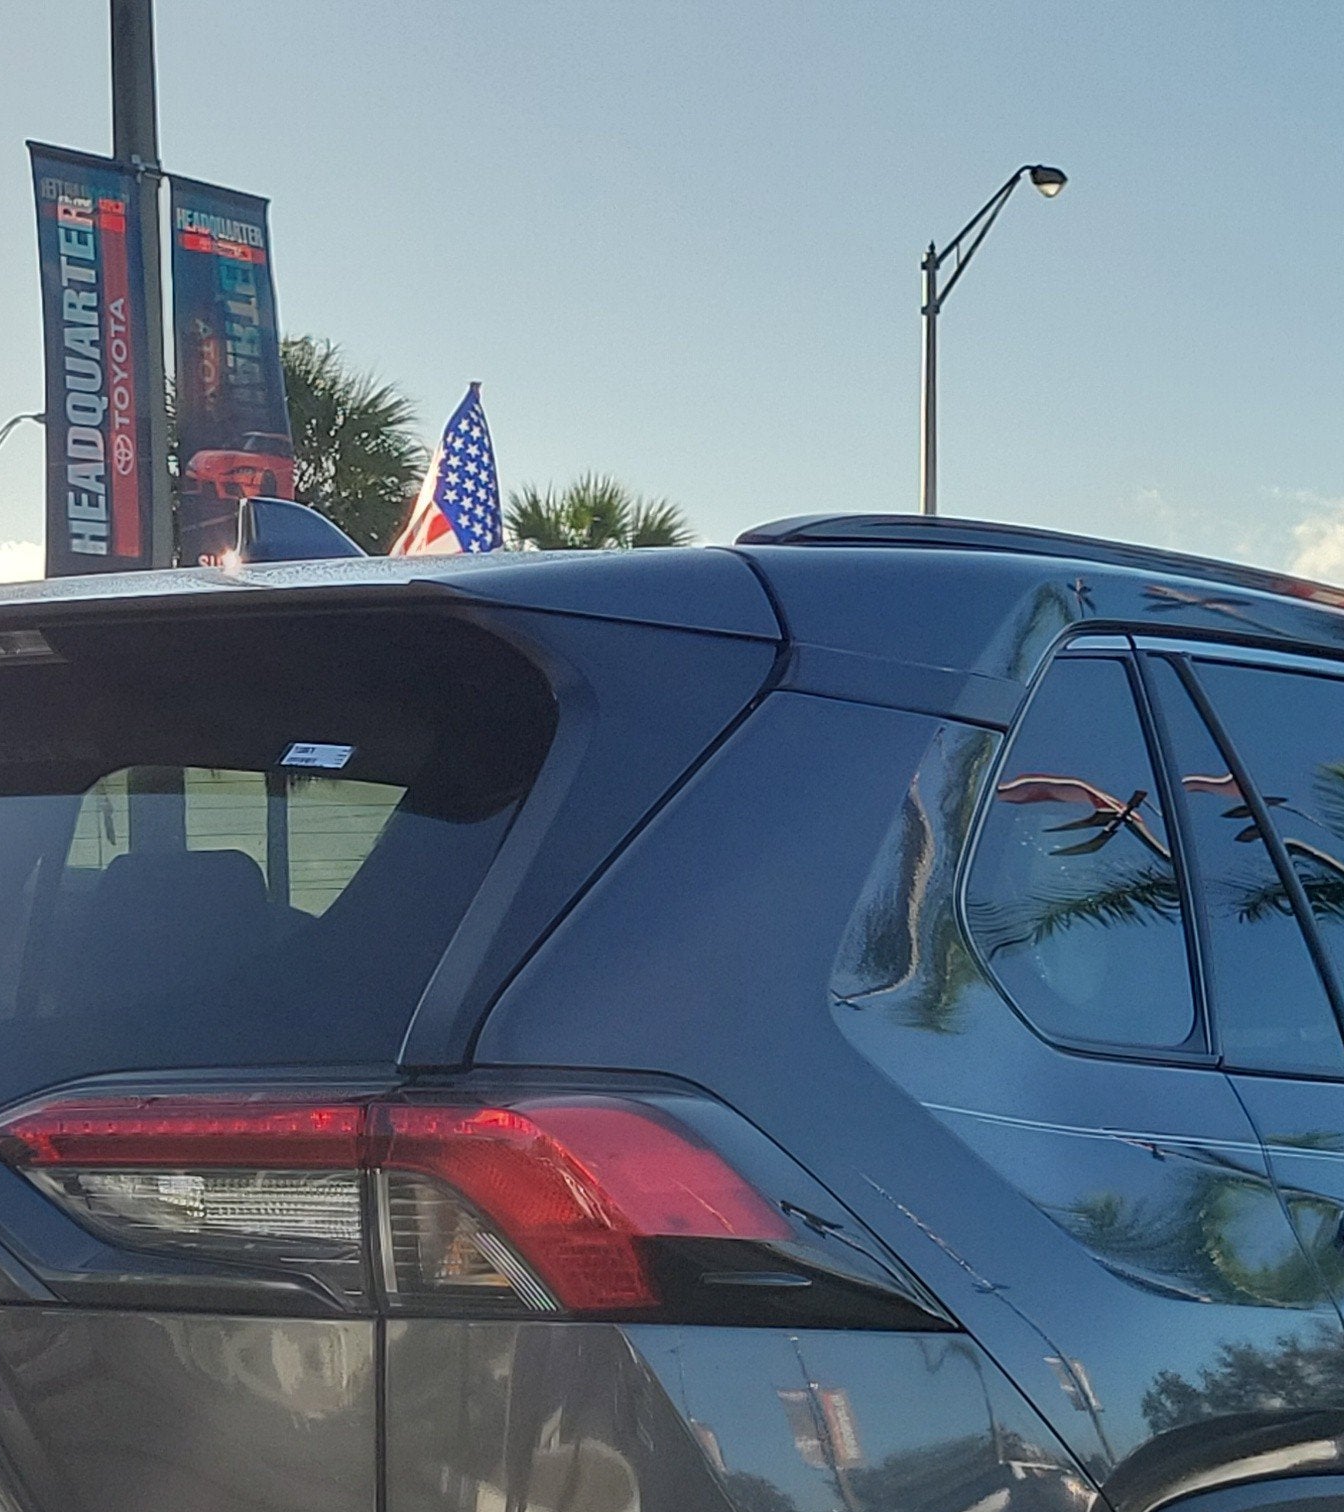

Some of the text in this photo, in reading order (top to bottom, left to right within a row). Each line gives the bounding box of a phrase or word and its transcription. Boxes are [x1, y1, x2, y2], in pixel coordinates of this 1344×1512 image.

[176, 207, 264, 249] HEADQUARTER
[58, 195, 109, 556] HEADQUARTER
[110, 298, 131, 431] TOYOTA
